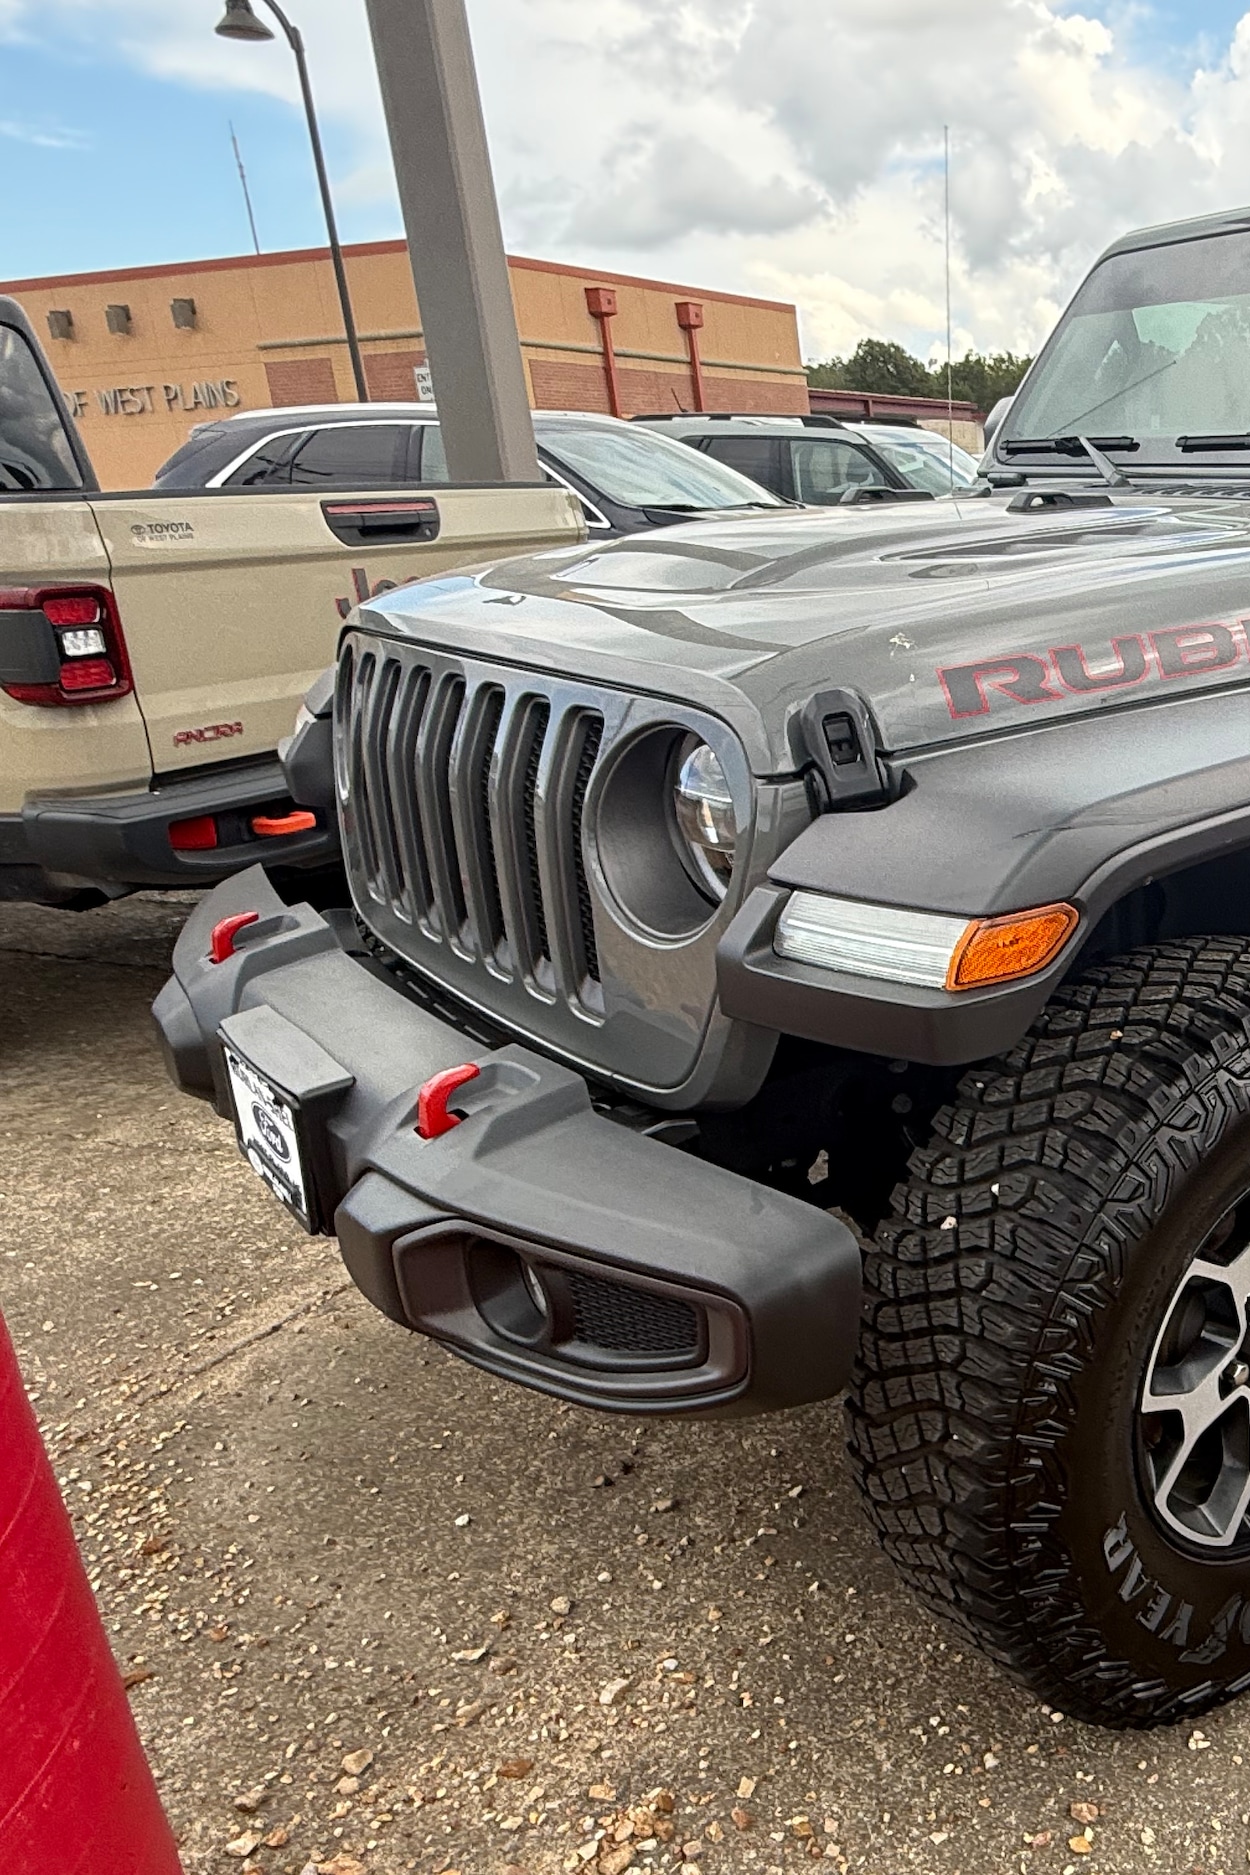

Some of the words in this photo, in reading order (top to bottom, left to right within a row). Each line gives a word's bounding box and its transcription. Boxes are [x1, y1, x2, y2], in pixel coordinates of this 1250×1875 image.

[95, 385, 155, 416] WEST
[162, 379, 241, 412] PLAINS
[147, 522, 195, 534] TOYOTA
